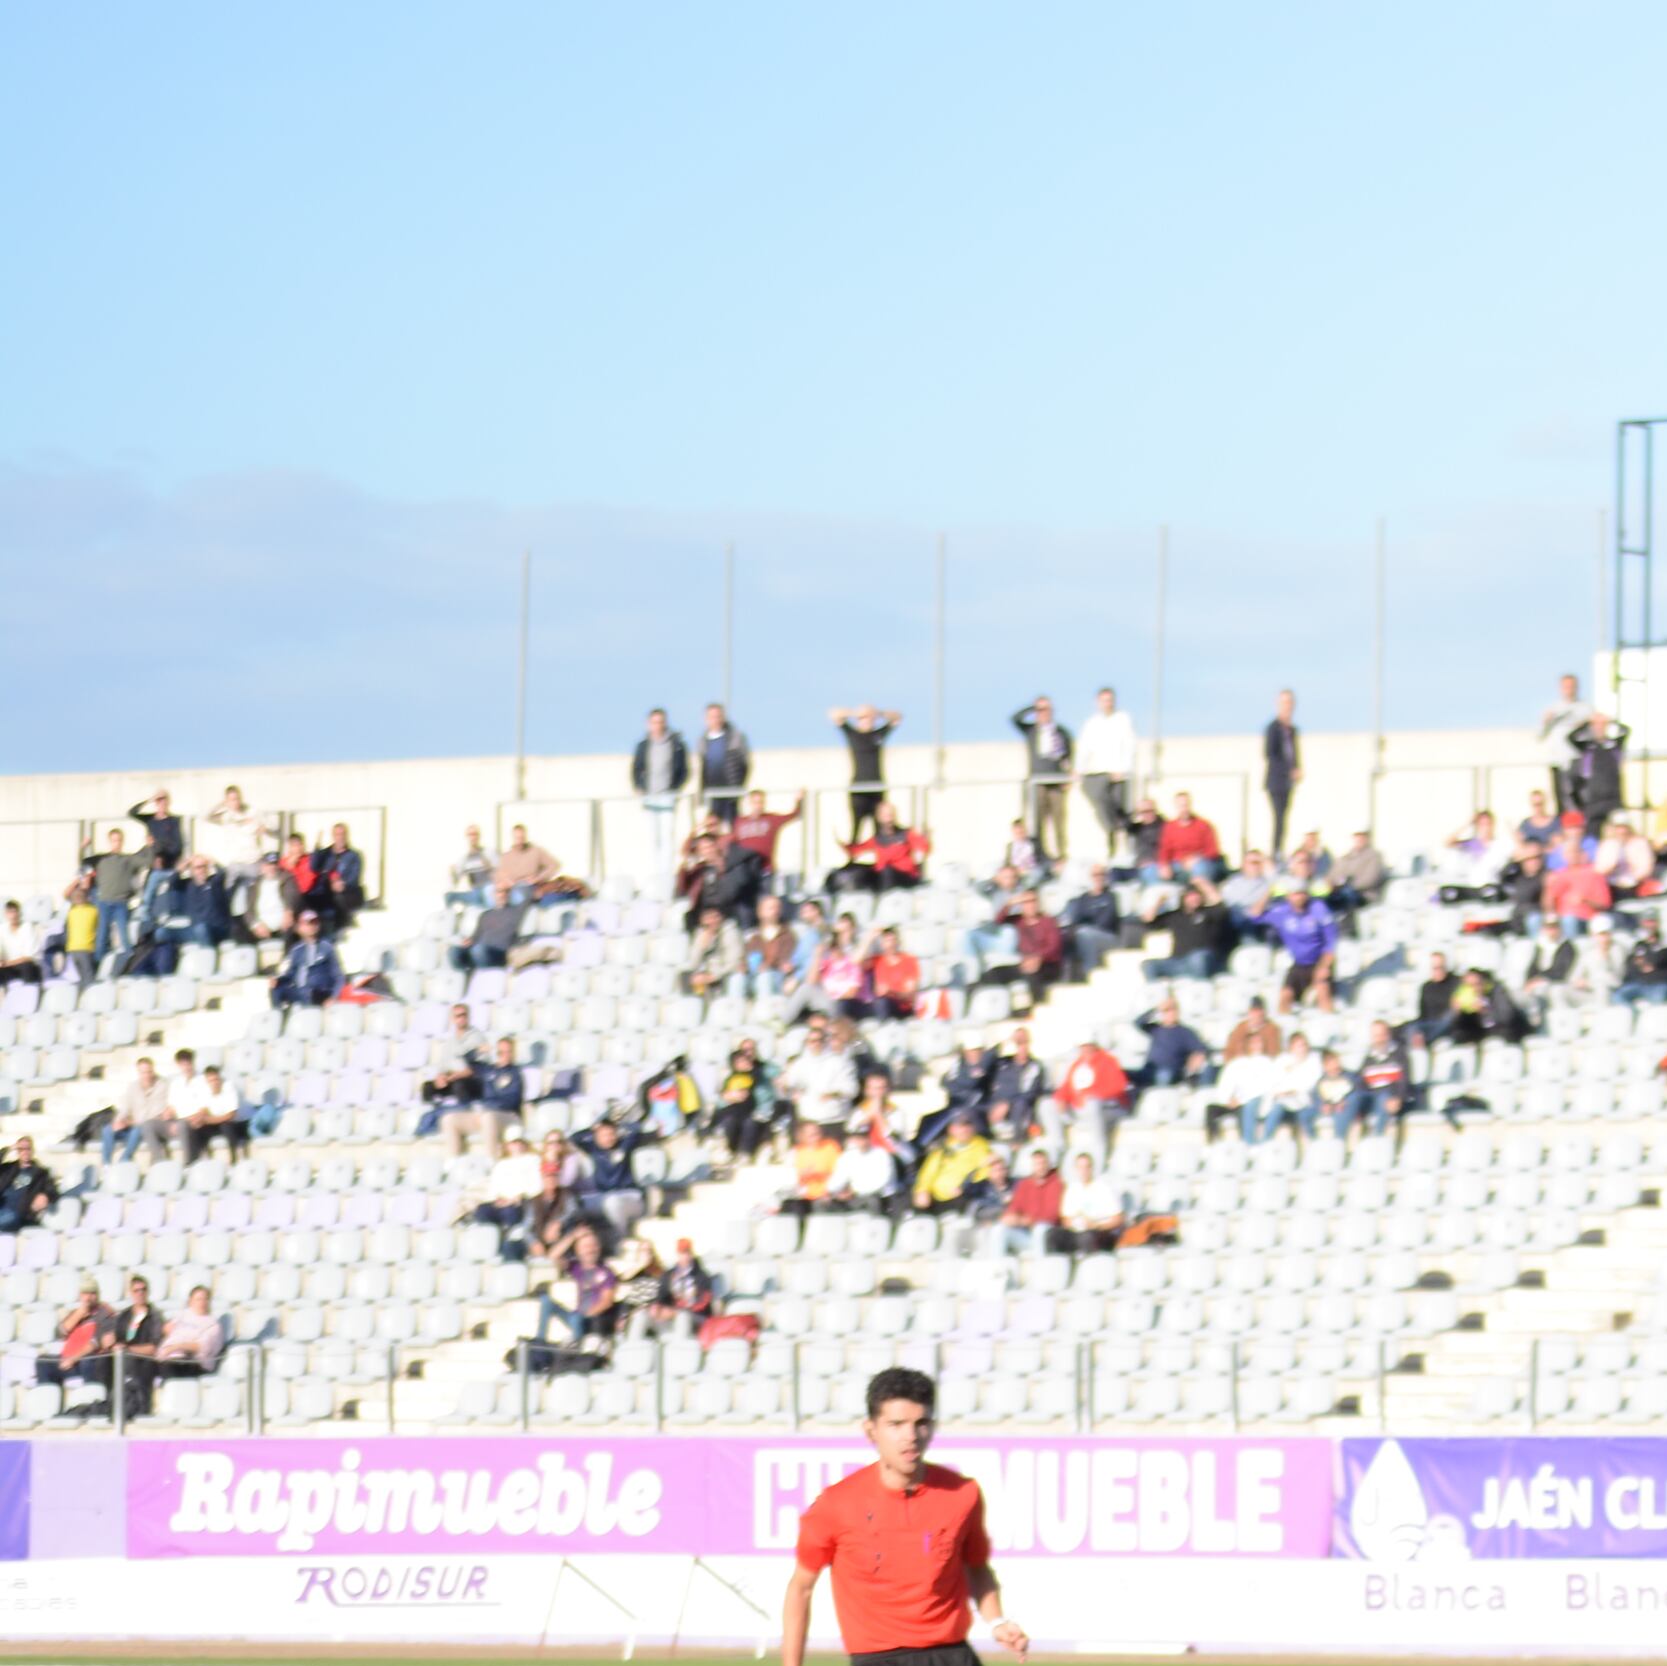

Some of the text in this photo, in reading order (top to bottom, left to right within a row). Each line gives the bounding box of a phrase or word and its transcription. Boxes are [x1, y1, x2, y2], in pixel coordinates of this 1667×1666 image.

[168, 1448, 663, 1552] Rapimueble
[1470, 1464, 1593, 1530] JAÉN
[295, 1565, 490, 1606] RODISUR
[1362, 1571, 1508, 1613] Blanca
